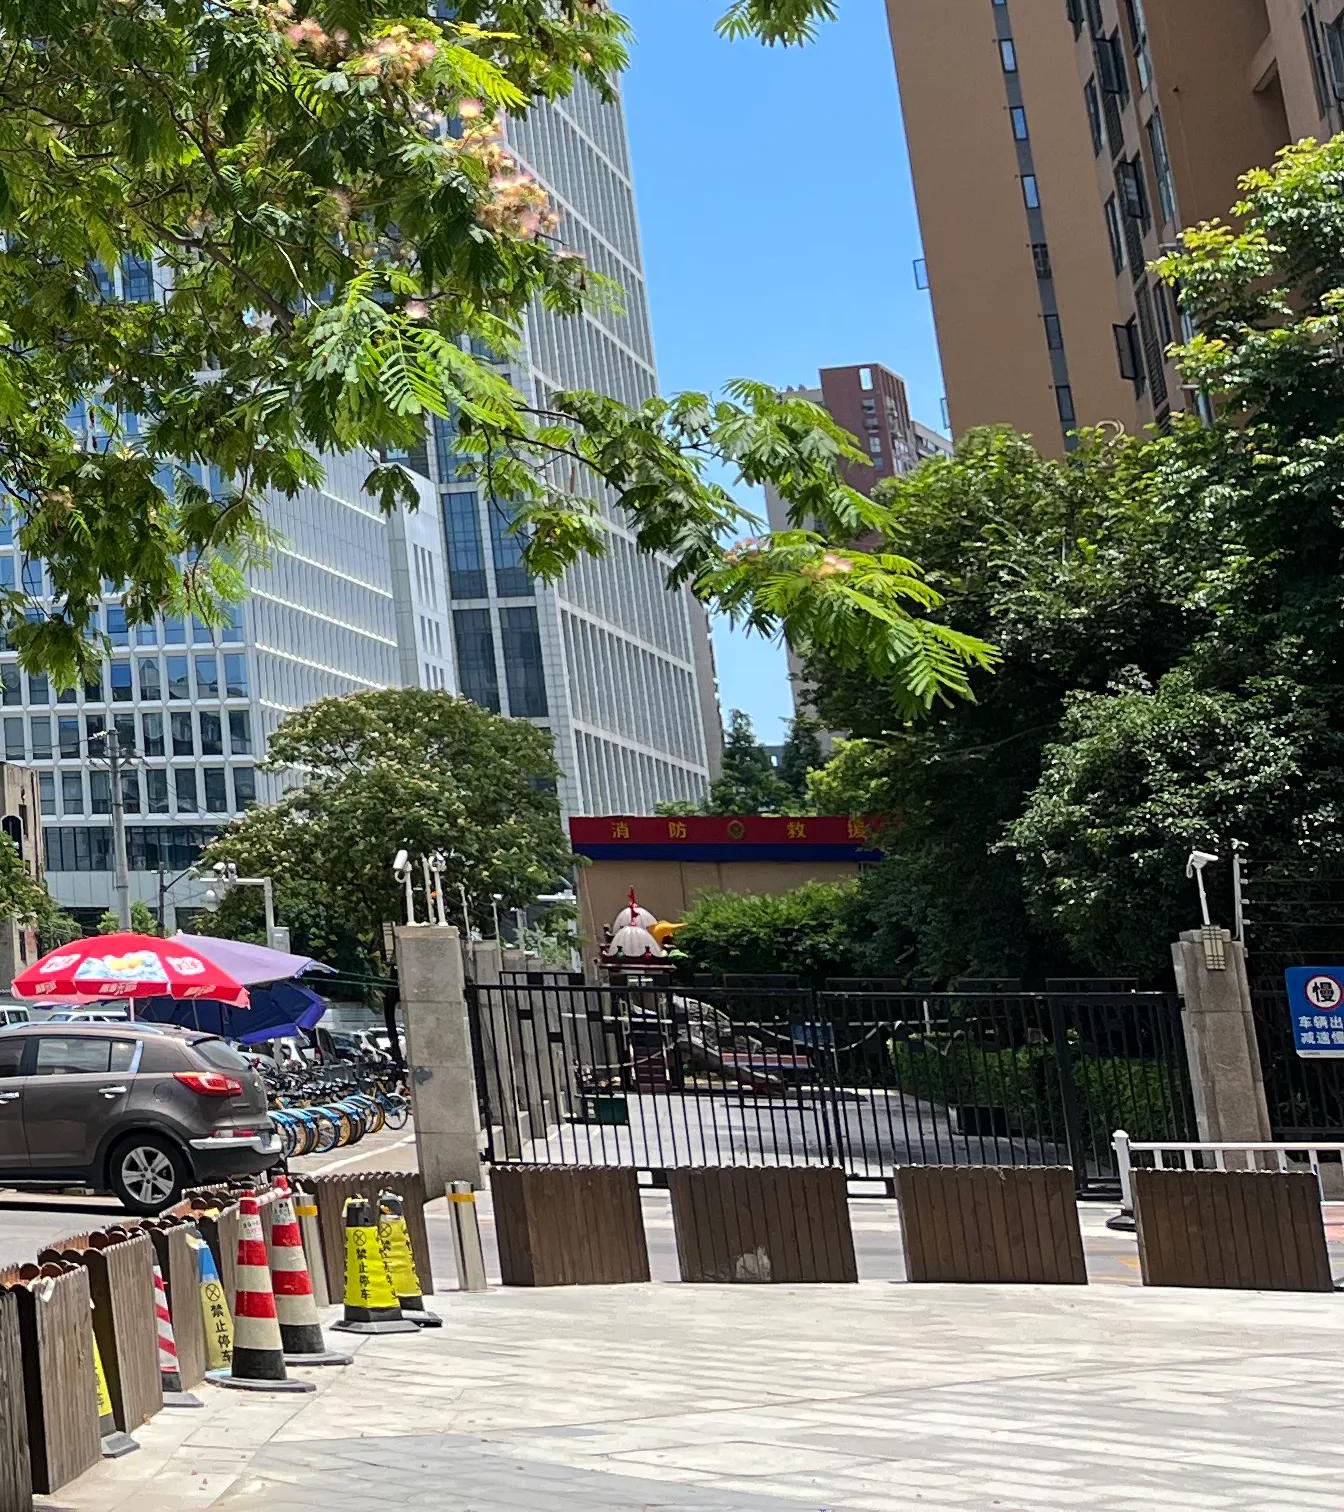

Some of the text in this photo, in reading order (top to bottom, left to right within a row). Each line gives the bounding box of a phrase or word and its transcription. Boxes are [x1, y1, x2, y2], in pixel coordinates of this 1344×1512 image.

[1312, 981, 1336, 1003] 慢
[356, 1247, 372, 1301] 禁止停车
[210, 1303, 233, 1363] 禁止停车
